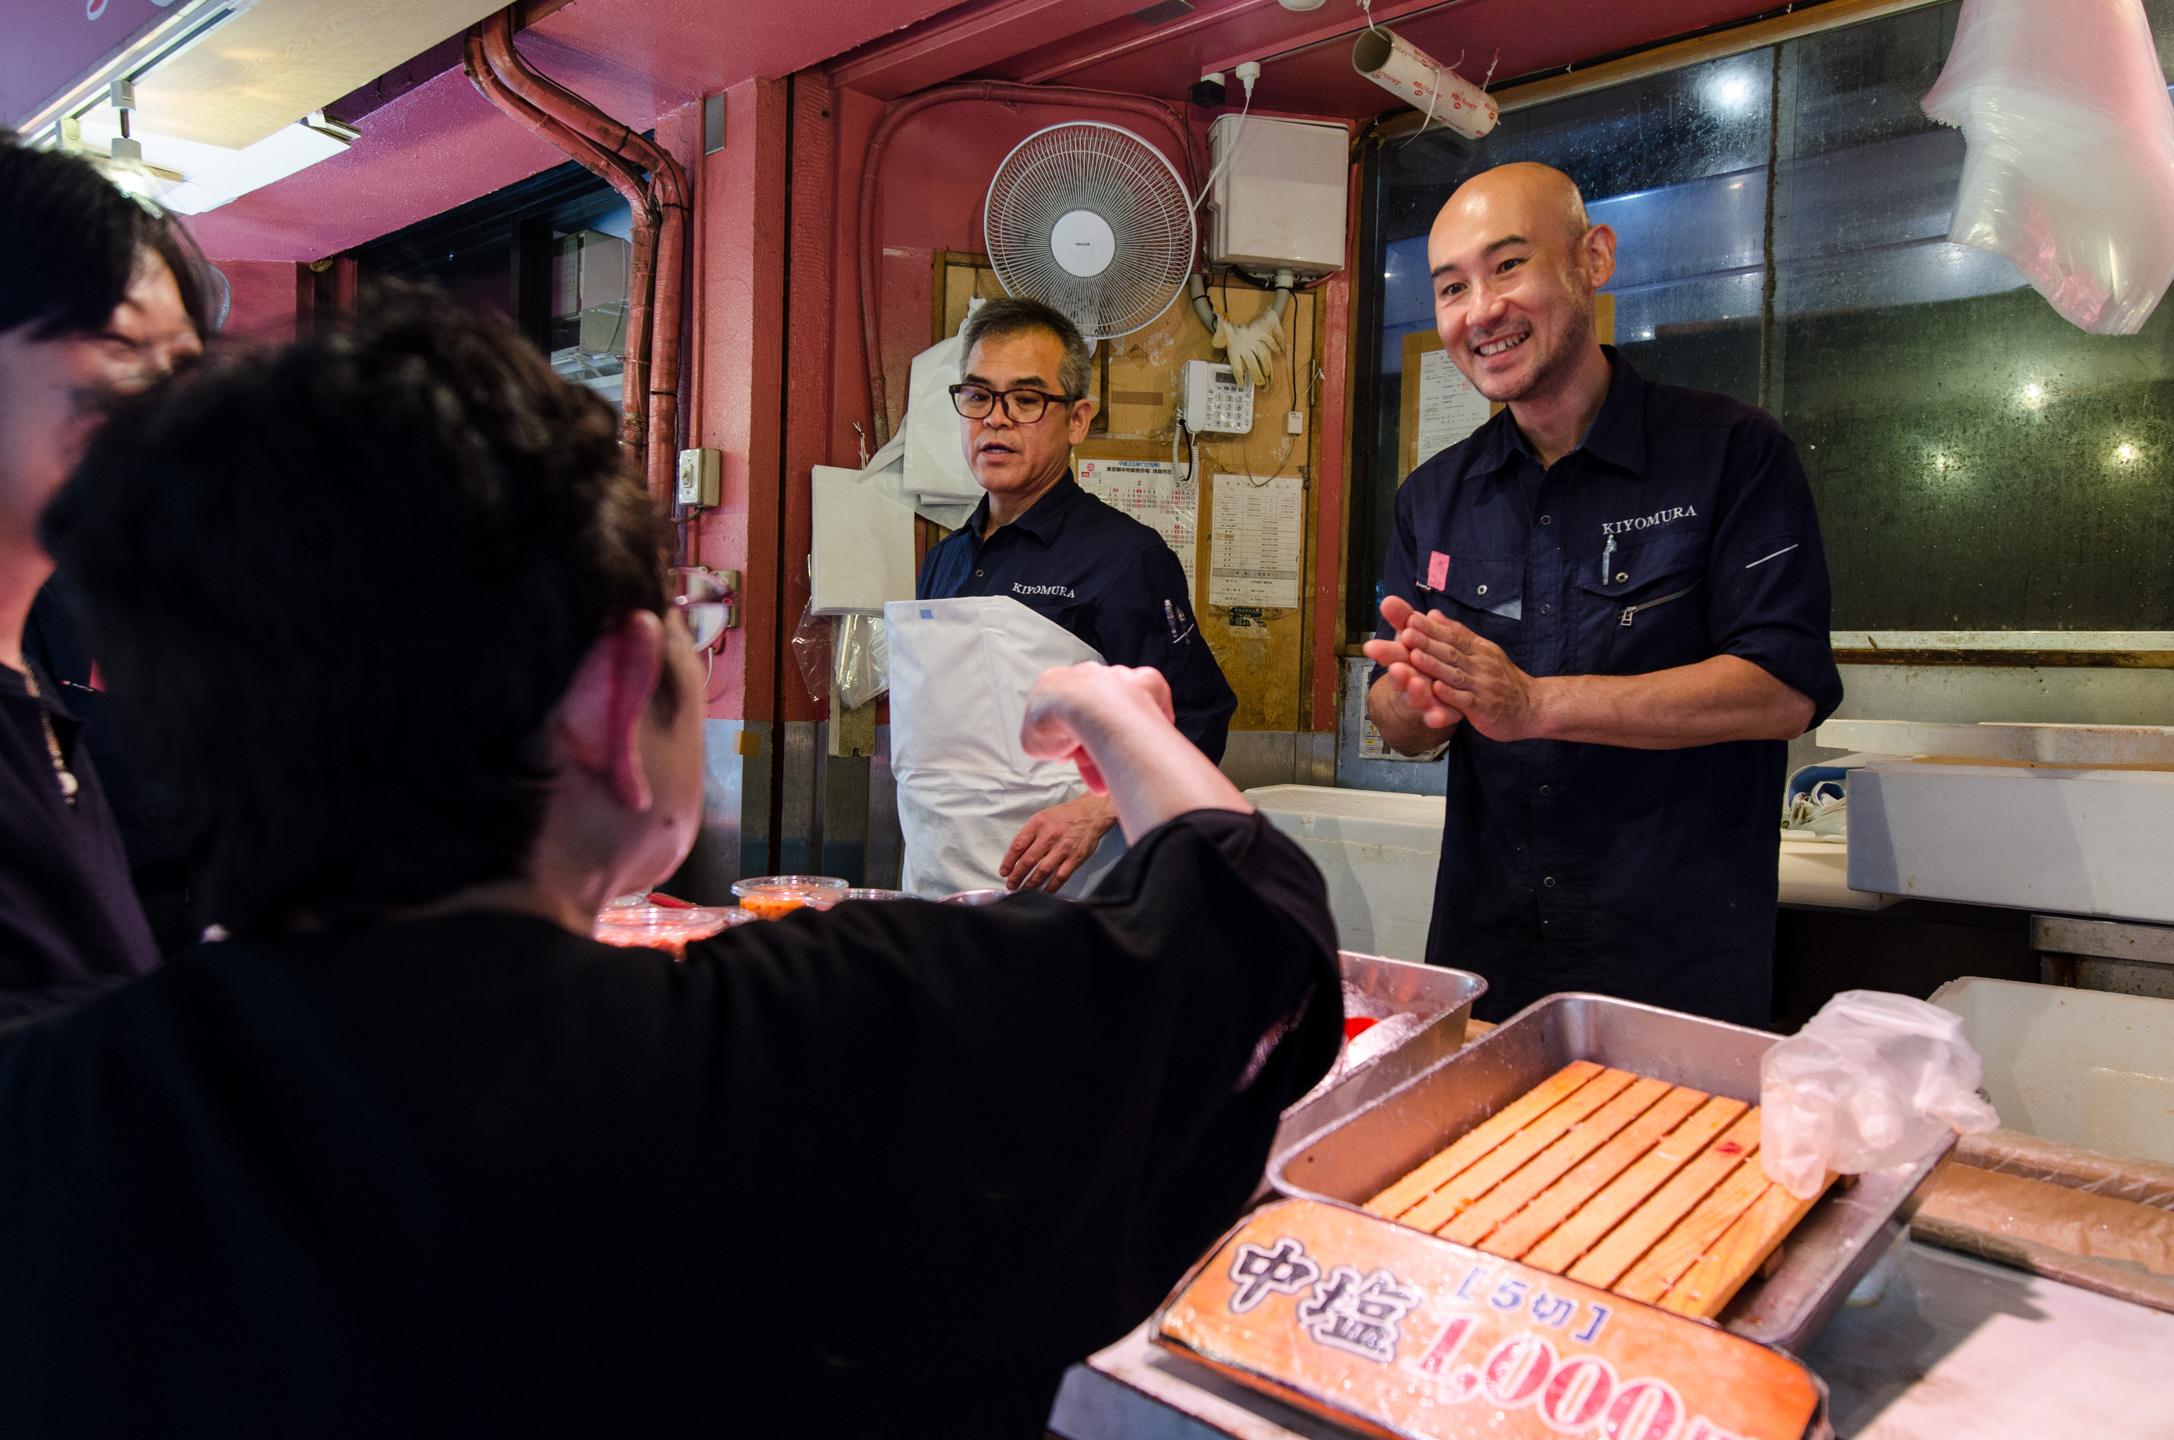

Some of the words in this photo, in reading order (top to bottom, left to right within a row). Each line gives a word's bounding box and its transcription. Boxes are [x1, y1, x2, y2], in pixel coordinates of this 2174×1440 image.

[1602, 505, 1697, 534] KIYOMURA
[1012, 582, 1075, 598] KIYOMURA
[1230, 1238, 1419, 1362] 中塩
